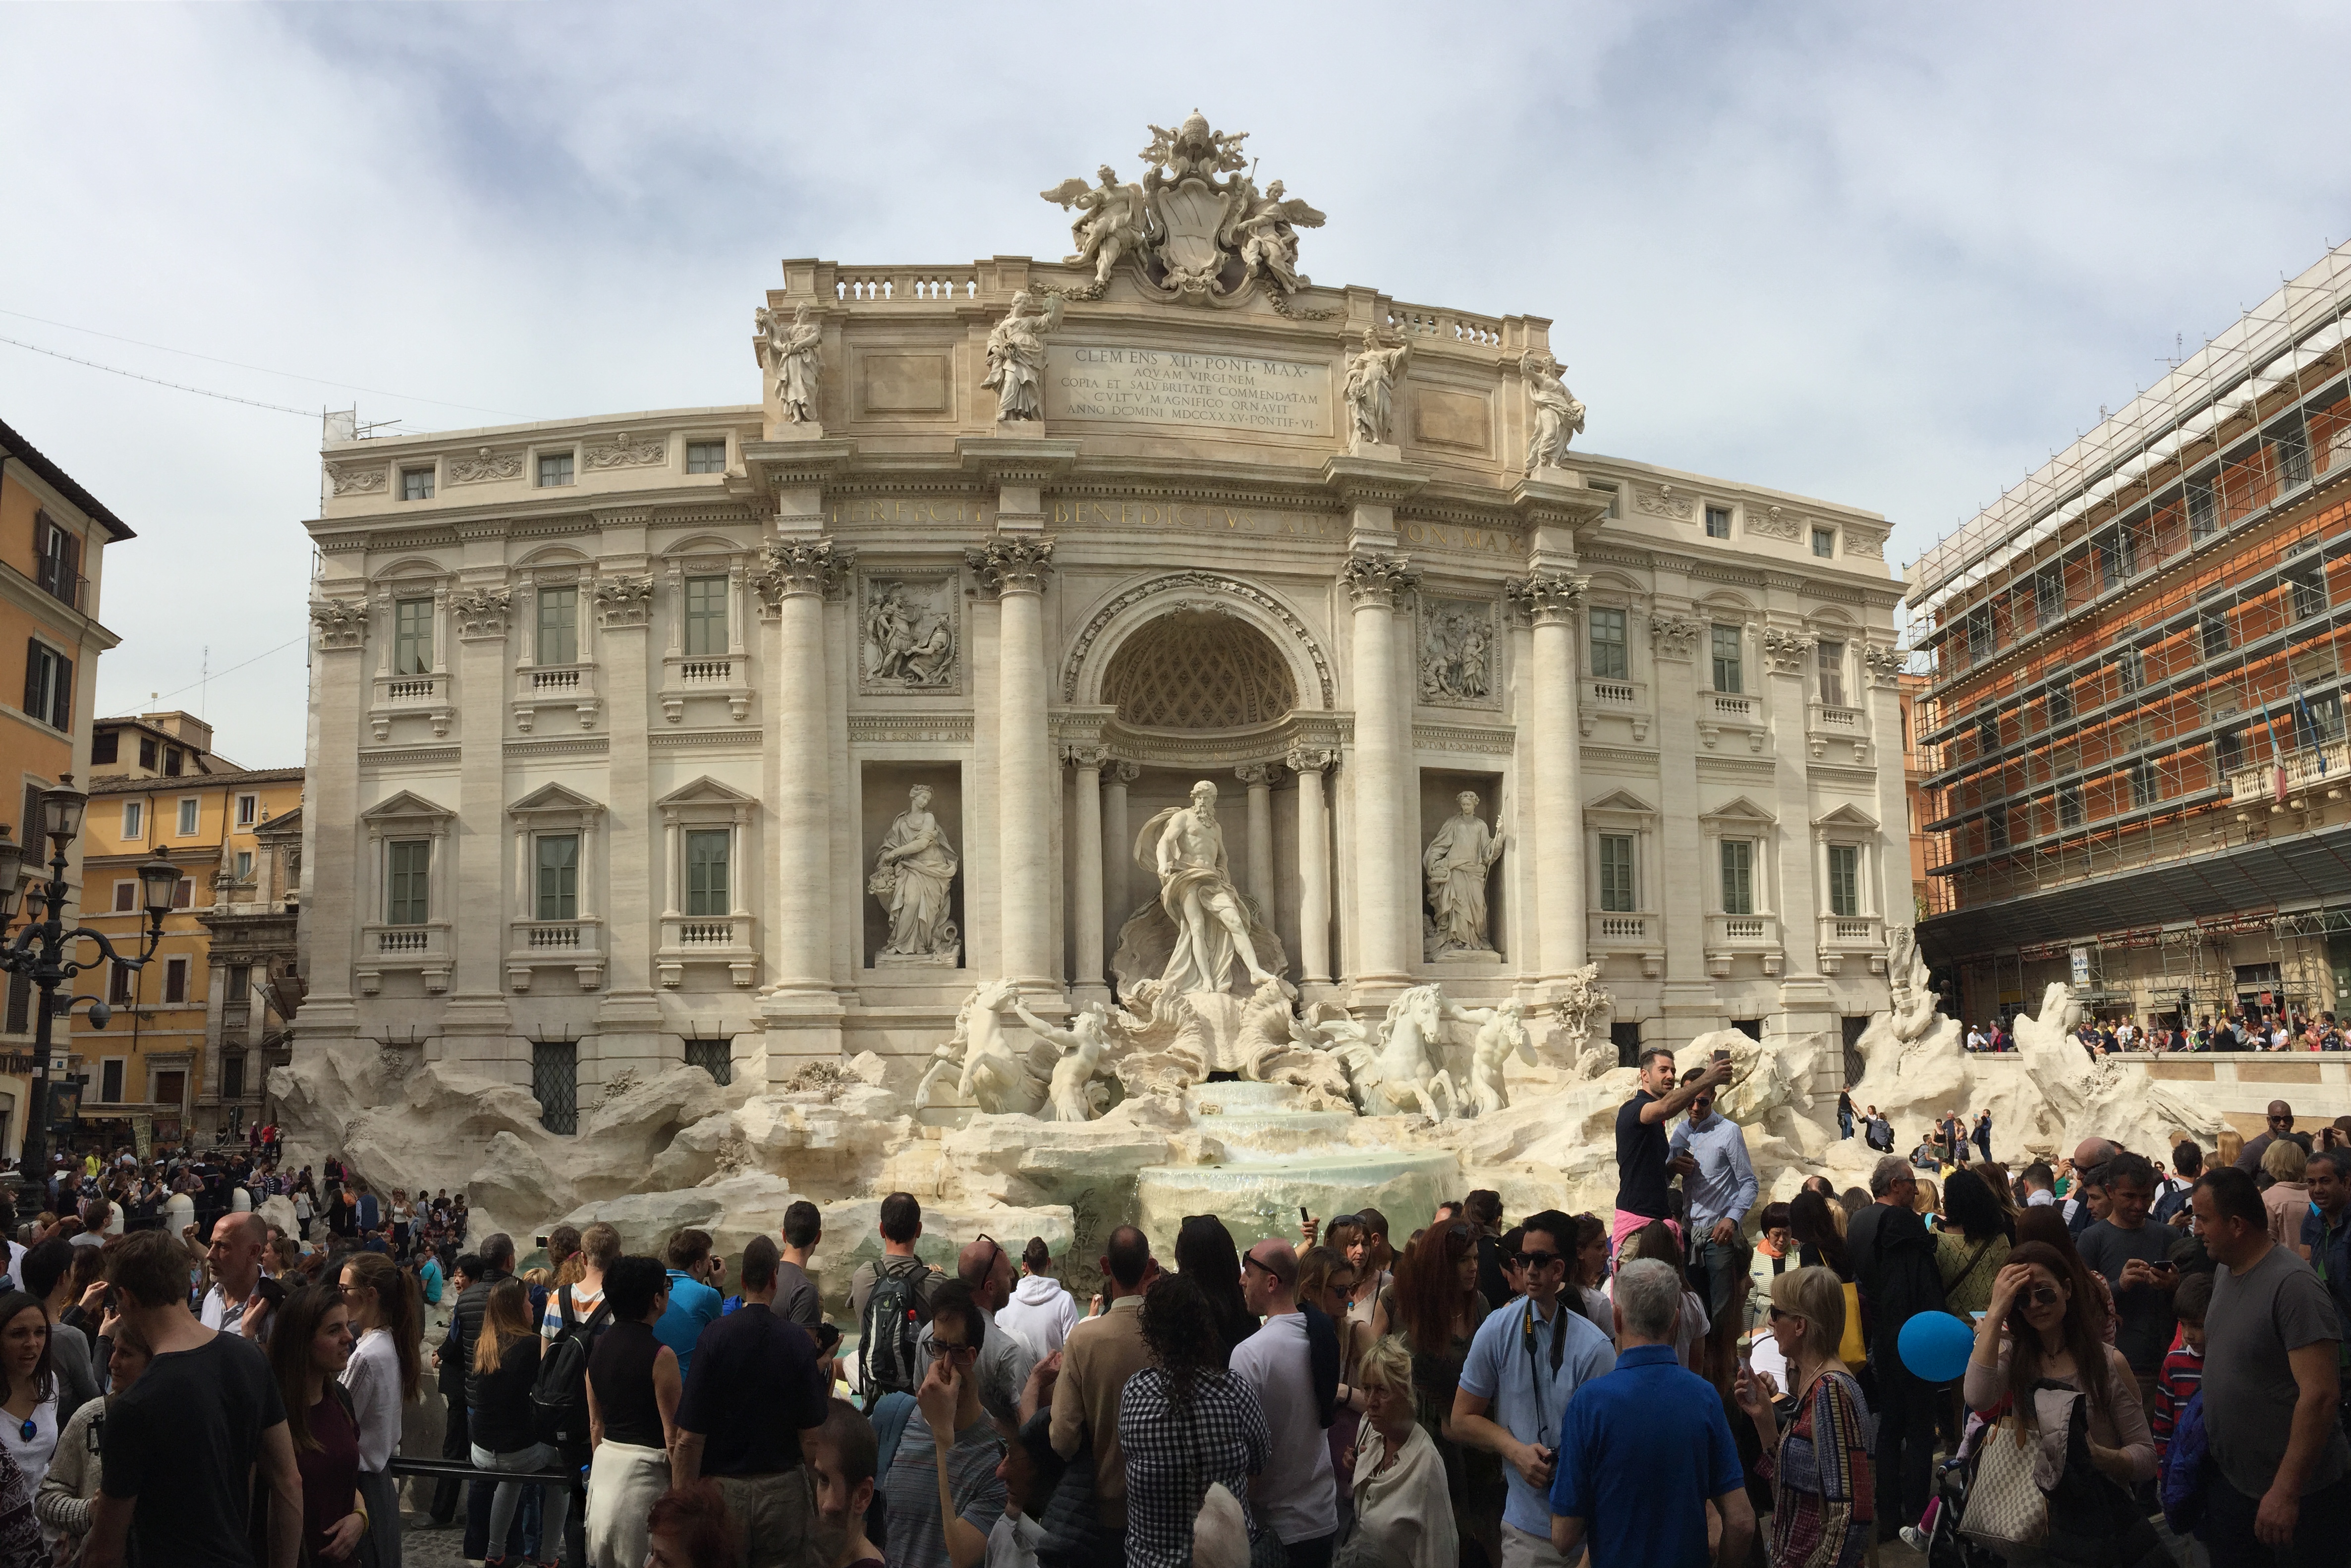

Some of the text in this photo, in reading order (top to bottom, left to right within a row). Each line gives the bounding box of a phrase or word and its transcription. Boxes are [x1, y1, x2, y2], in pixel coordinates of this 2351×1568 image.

[1075, 349, 1158, 365] CLEMENS
[1133, 368, 1255, 386] AQVAM VIRGINEM
[1061, 378, 1319, 404] COPIA ET SALVBRITATE COMMENDATAM
[1067, 404, 1105, 415] ANNO
[1094, 392, 1288, 414] CVLTV MAGNIFICO ORNAVIT
[832, 501, 988, 523] PERFECIT
[1054, 503, 1255, 531] BENEDICTVS
[849, 732, 886, 741] POSITIS
[893, 732, 922, 741] SIGNIS
[947, 732, 970, 740] ANA
[1262, 744, 1280, 755] OPVS
[1283, 738, 1295, 749] CVM
